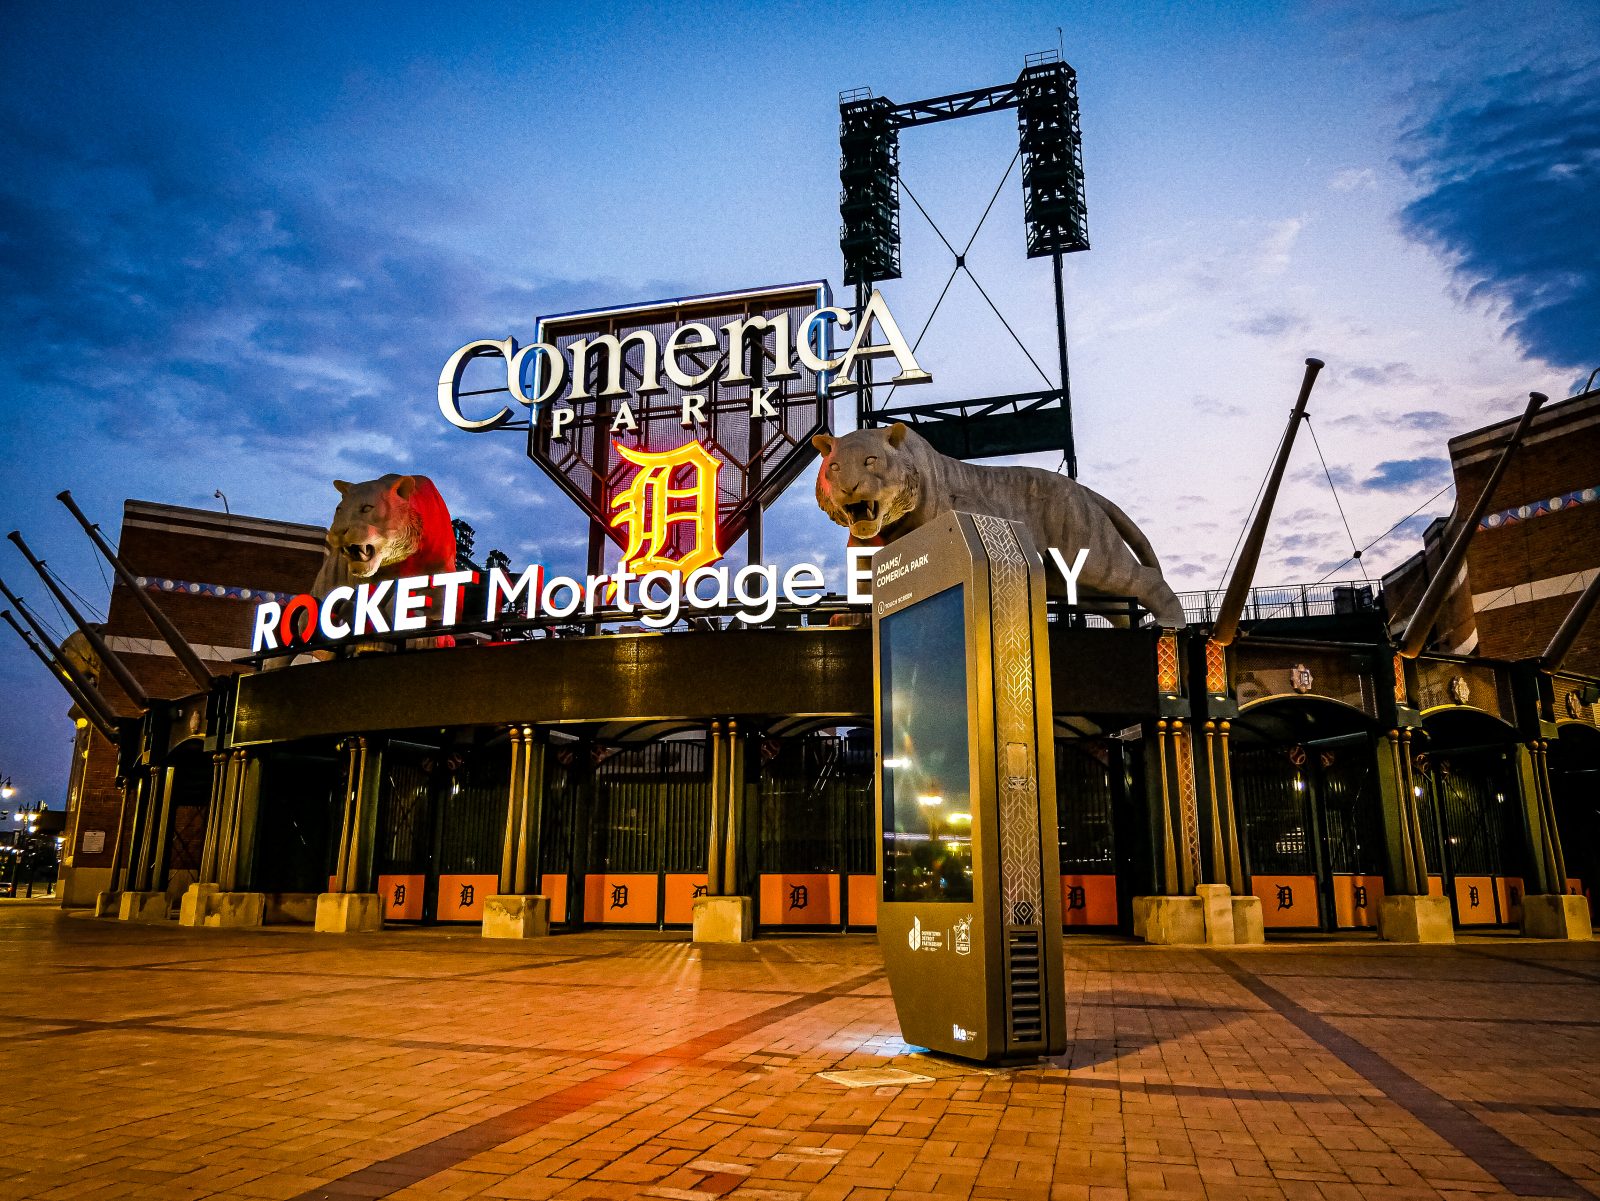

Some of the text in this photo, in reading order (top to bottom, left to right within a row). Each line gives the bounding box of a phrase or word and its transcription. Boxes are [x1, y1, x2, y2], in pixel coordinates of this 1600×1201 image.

[551, 386, 780, 440] PARK
[876, 553, 901, 576] ADAMS/
[876, 553, 929, 588] COMERICA PARK
[252, 569, 475, 653] ROCKET
[486, 561, 826, 629] Mortgage
